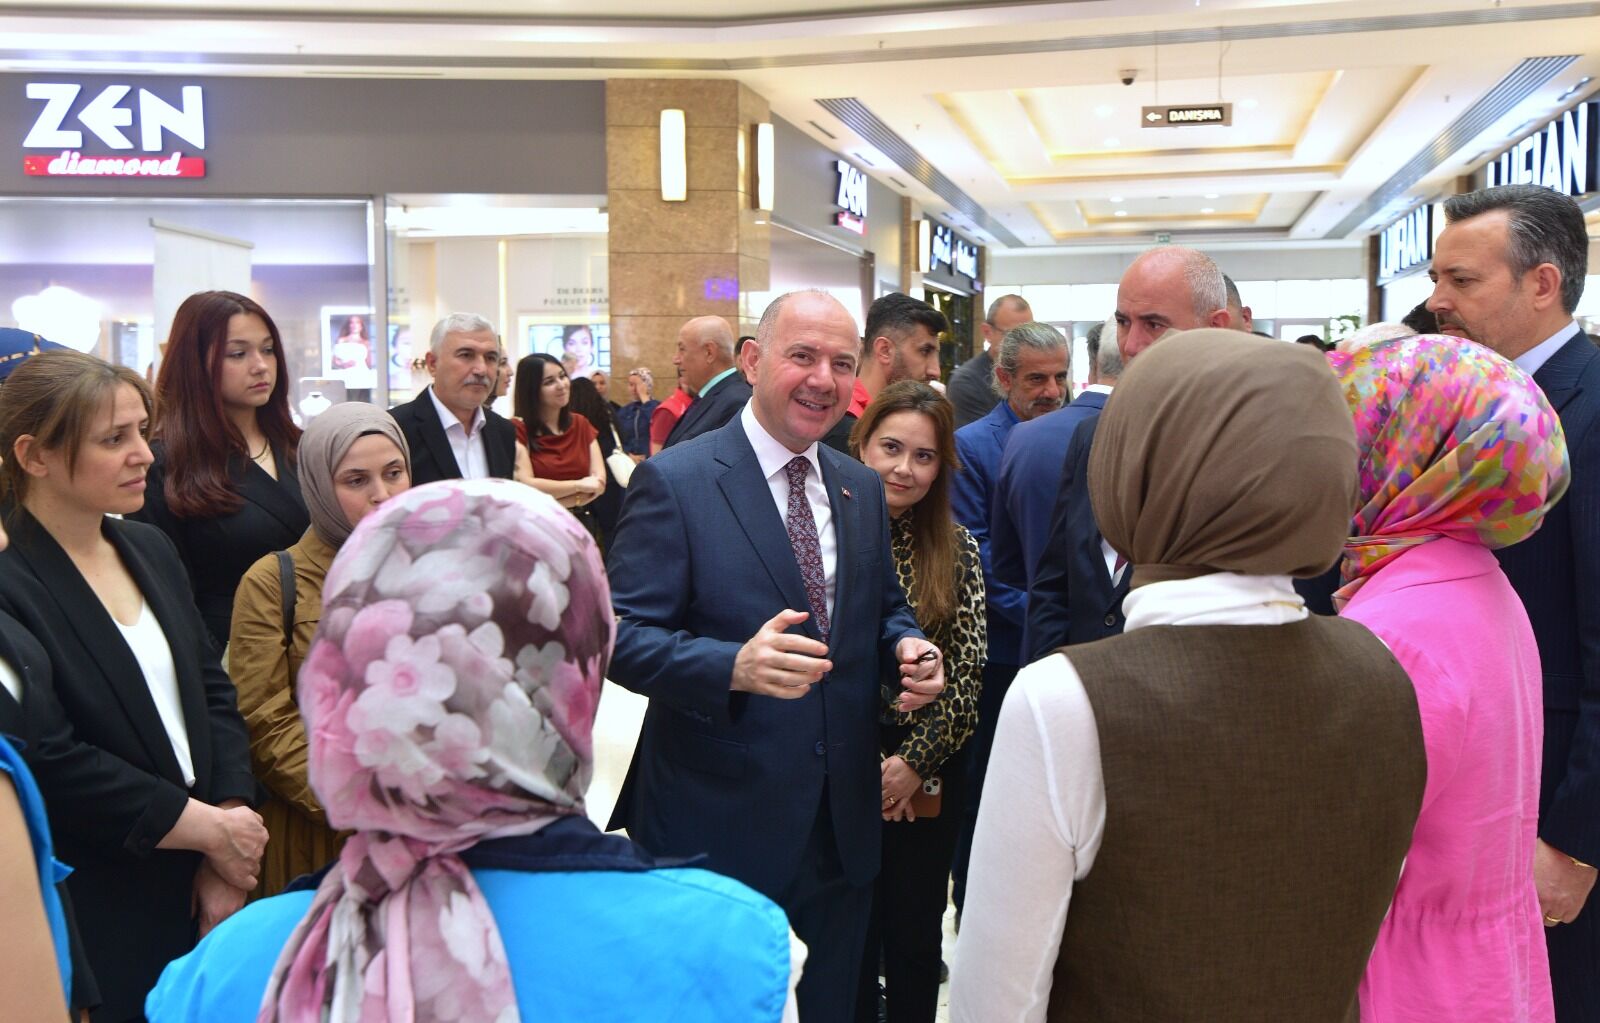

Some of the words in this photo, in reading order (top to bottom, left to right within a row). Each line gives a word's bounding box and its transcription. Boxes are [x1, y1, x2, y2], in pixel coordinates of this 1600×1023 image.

[22, 83, 205, 151] ZEN
[47, 150, 182, 175] diamond
[838, 159, 867, 217] ZEN
